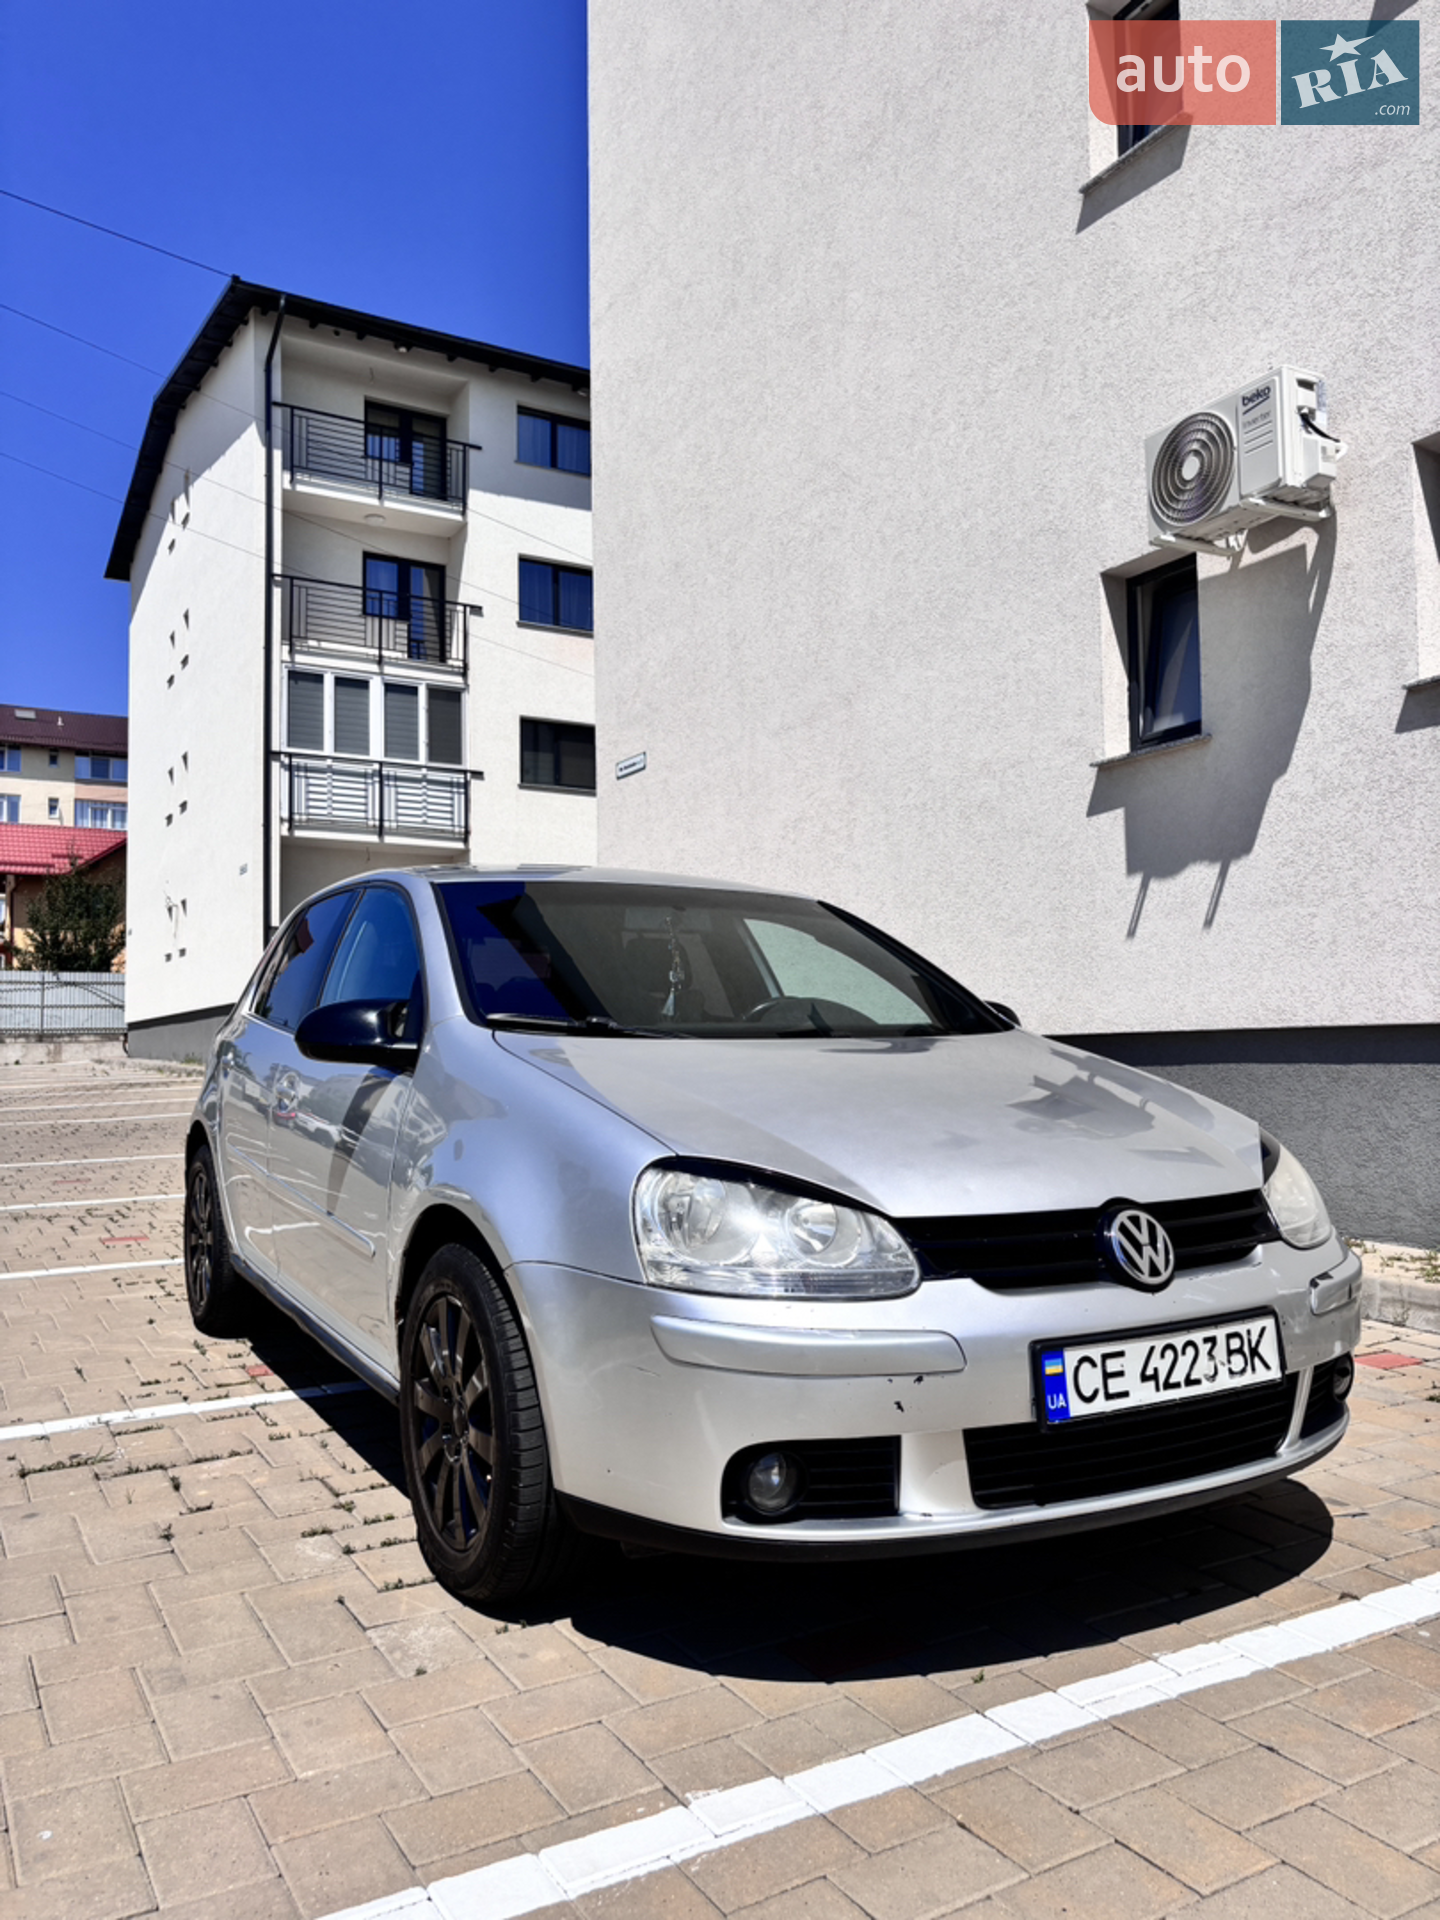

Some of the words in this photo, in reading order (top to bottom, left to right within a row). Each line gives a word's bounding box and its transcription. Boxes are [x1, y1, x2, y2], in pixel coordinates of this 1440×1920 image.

[1242, 386, 1271, 406] beko
[1073, 1350, 1130, 1404] CE
[1139, 1335, 1219, 1393] 4223
[1047, 1393, 1067, 1410] UA
